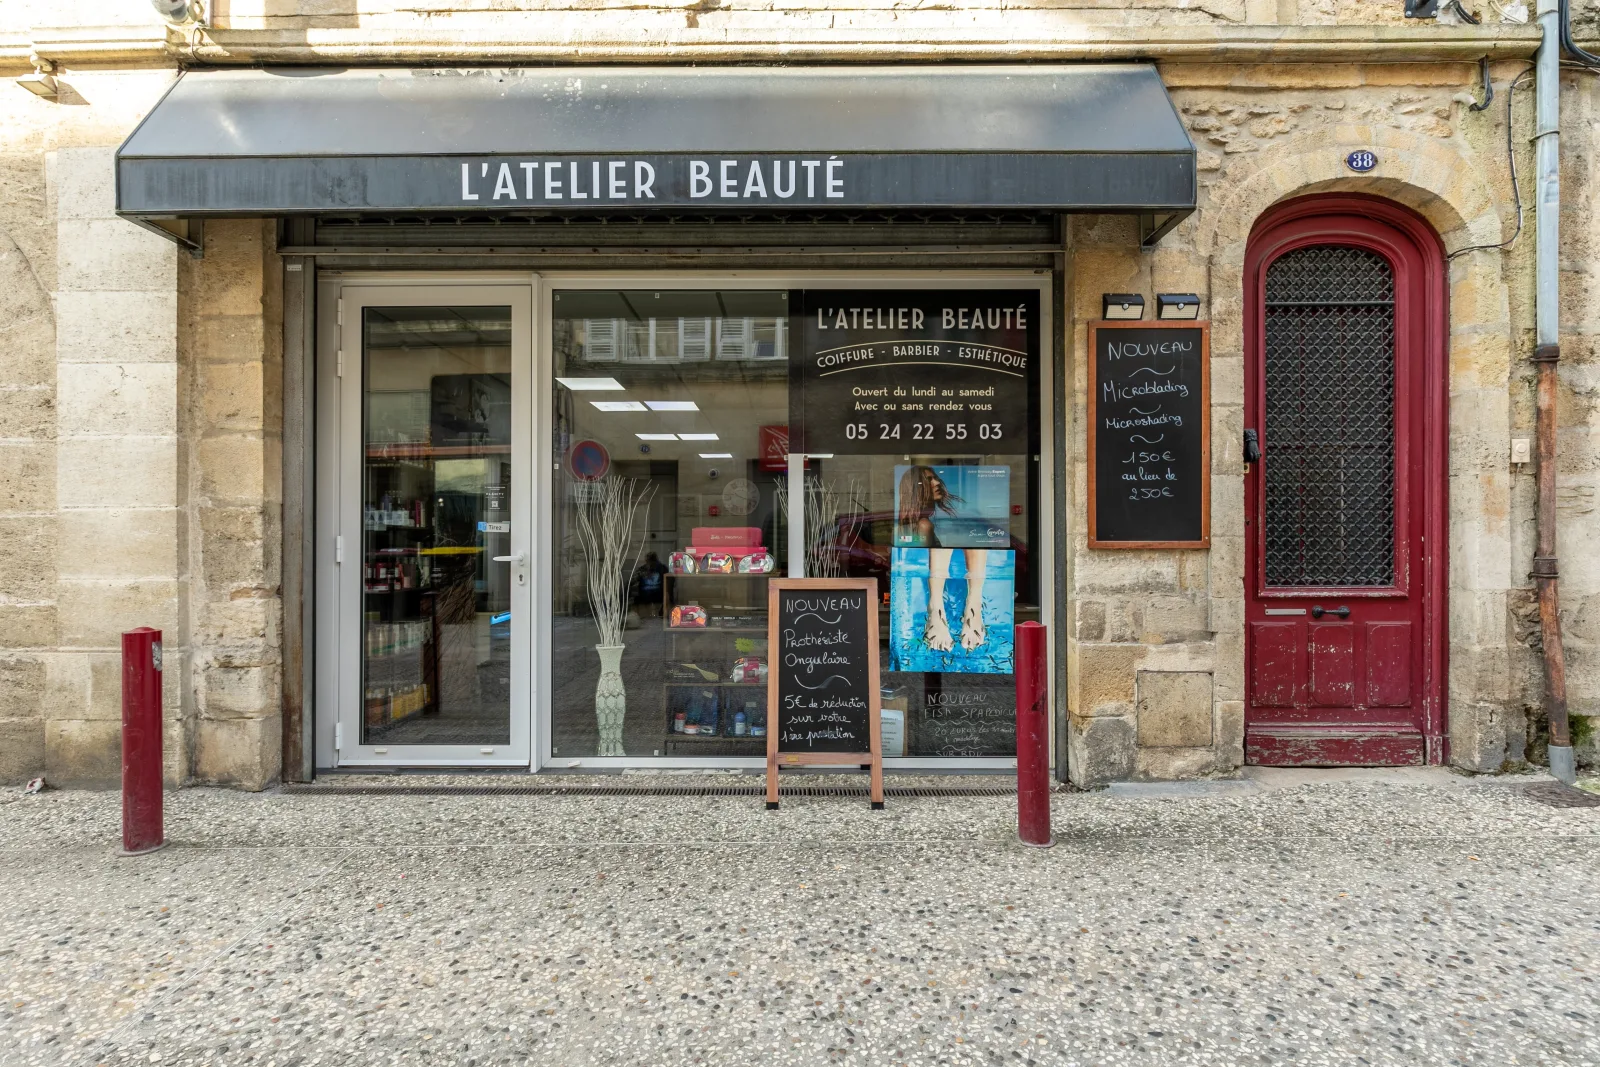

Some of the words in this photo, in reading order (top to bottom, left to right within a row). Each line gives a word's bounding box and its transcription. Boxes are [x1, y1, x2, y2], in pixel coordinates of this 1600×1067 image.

[1352, 152, 1373, 168] 38
[461, 161, 656, 201] L'ATELIER
[689, 155, 844, 198] BEAUTÉ
[817, 307, 925, 330] L'ATELIER
[942, 303, 1027, 330] BEAUTÉ
[816, 347, 875, 368] COIFFURE
[892, 345, 940, 357] BARBIER
[958, 346, 1028, 369] ESTHÉTIQUE
[1107, 341, 1193, 361] NOUVEAU
[852, 386, 889, 397] Ouvert
[893, 386, 907, 397] du
[911, 386, 936, 397] lundi
[941, 388, 955, 397] au
[958, 386, 995, 397] samedi
[854, 401, 878, 411] Avec
[883, 402, 897, 411] ou
[901, 402, 924, 411] sans
[928, 401, 964, 411] rendez
[968, 402, 993, 411] vous
[845, 423, 869, 440] 05
[879, 423, 901, 440] 24
[912, 423, 934, 440] 22
[945, 423, 968, 440] 55
[978, 423, 1003, 440] 03
[1122, 451, 1176, 464] 150€
[1121, 472, 1138, 482] au
[1139, 467, 1161, 481] lieu
[1165, 468, 1178, 481] de
[1128, 487, 1174, 500] 250€
[785, 596, 862, 614] NOUVEAU
[784, 652, 851, 674] Ongulaire
[784, 694, 806, 710] 5€
[808, 699, 819, 709] de
[820, 695, 867, 710] réduction
[927, 693, 988, 704] NOUVEAU
[786, 713, 814, 725] sur
[818, 711, 851, 723] votre
